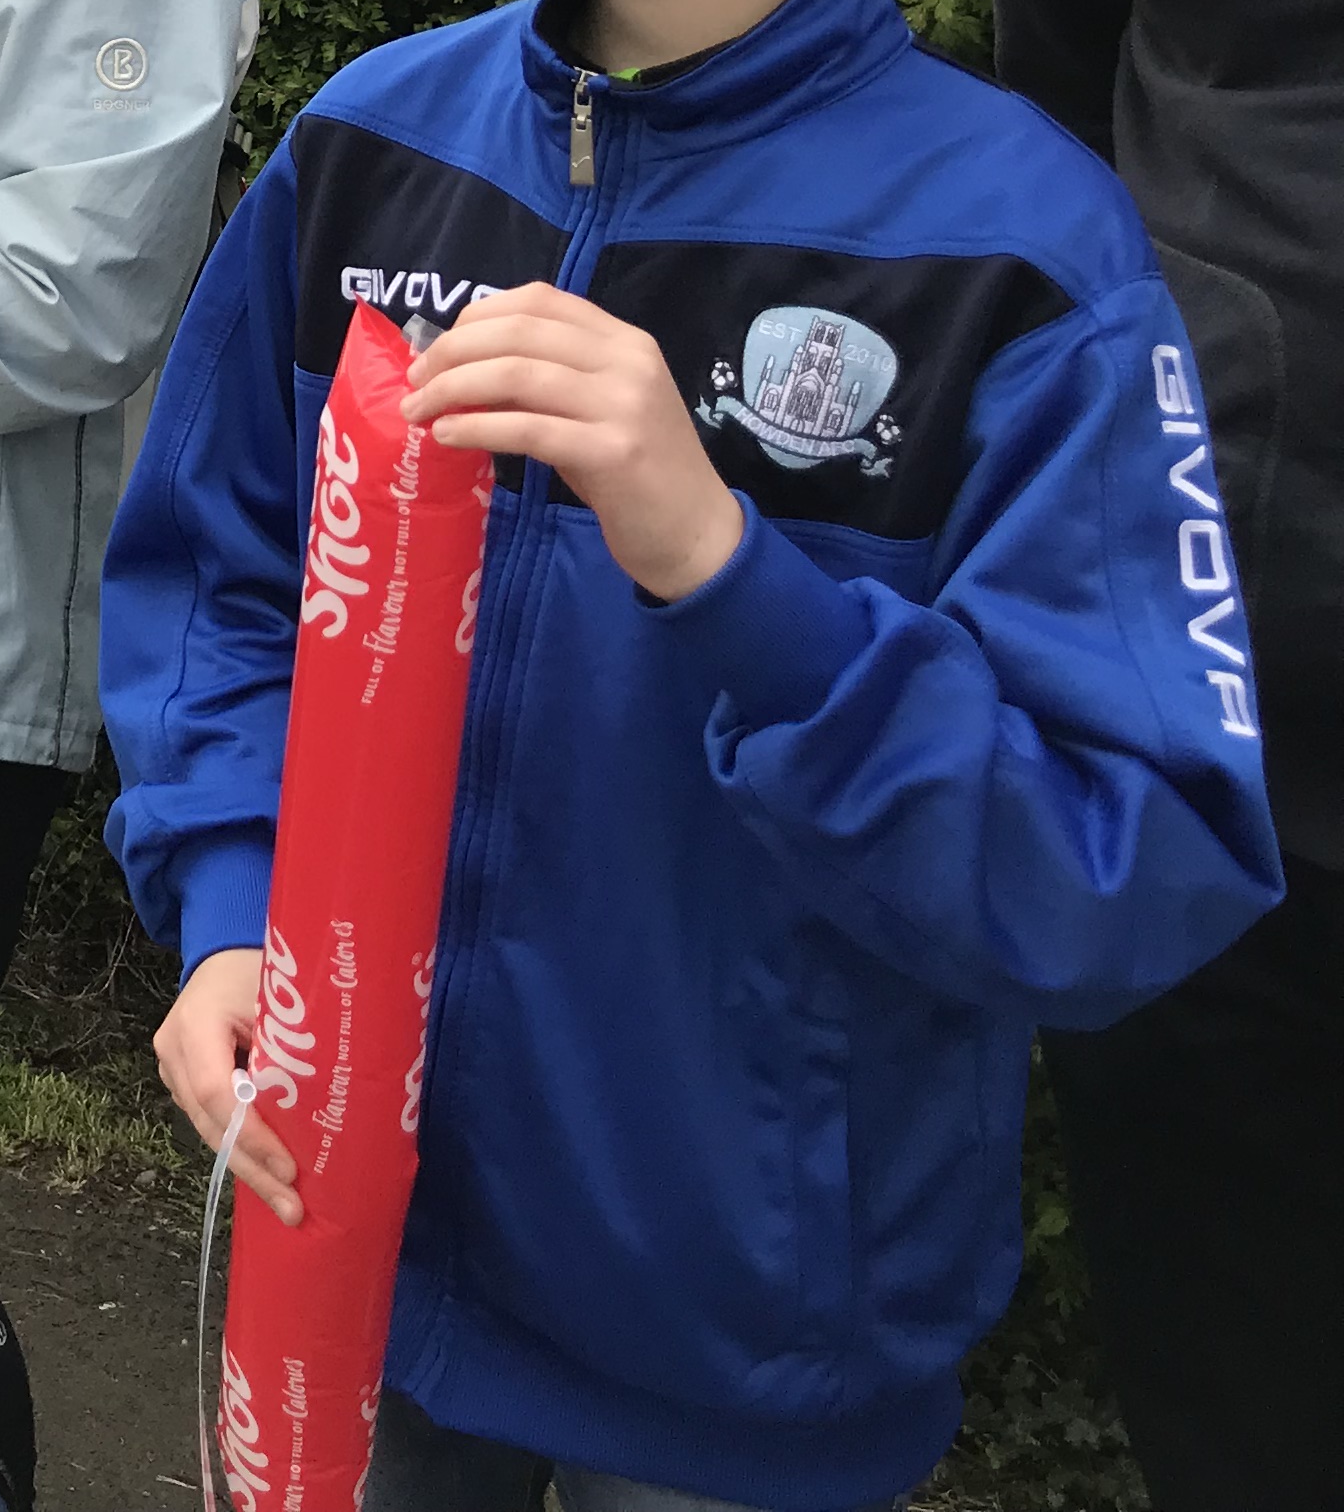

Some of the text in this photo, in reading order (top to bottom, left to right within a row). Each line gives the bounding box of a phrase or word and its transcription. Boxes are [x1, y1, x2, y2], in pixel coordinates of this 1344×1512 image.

[758, 318, 802, 343] EST
[844, 344, 893, 372] 2010
[389, 423, 426, 501] Calories
[395, 519, 410, 547] FULL
[394, 549, 408, 575] NOT
[363, 578, 409, 654] Flavour
[372, 657, 385, 674] OF
[361, 674, 380, 705] FULL
[340, 991, 353, 1008] OF
[340, 1009, 353, 1038] FULL
[338, 1039, 352, 1062] NOT
[312, 1064, 353, 1132] Flavour
[322, 1132, 333, 1148] OF
[314, 1148, 330, 1175] FULL
[281, 1356, 309, 1419] Calories
[293, 1420, 303, 1434] OF
